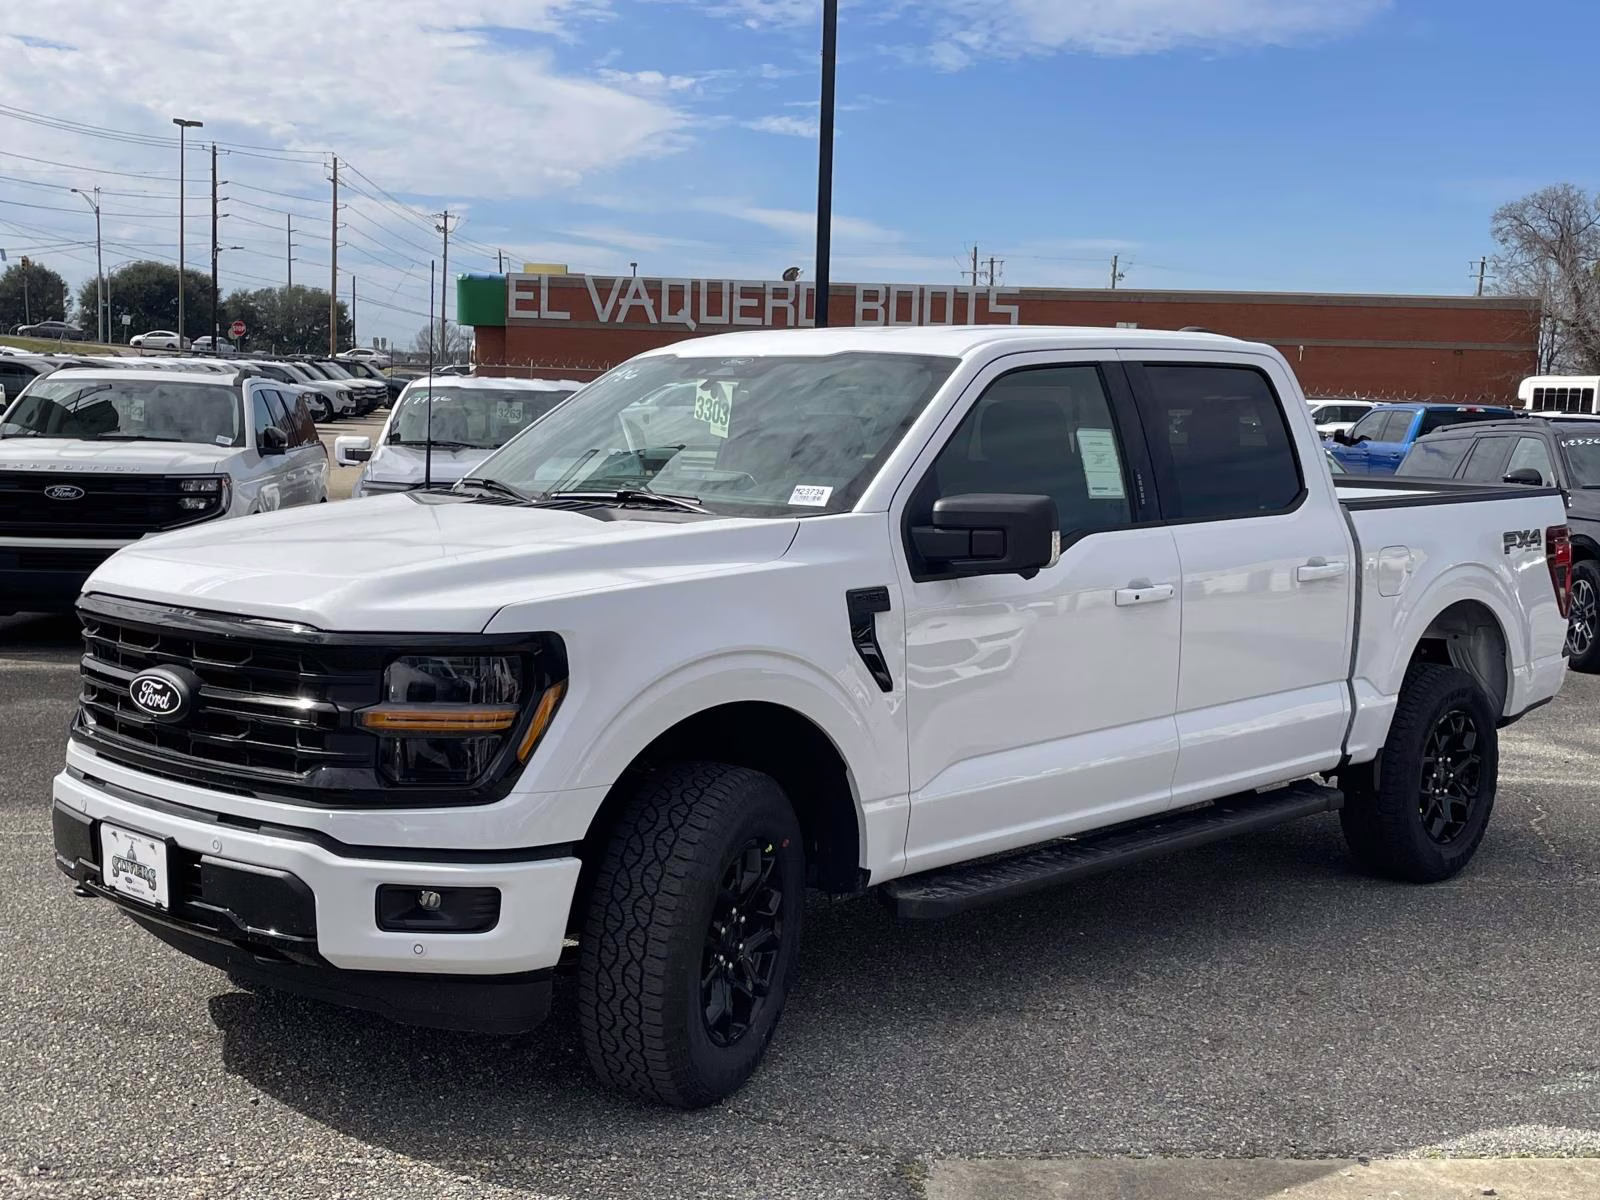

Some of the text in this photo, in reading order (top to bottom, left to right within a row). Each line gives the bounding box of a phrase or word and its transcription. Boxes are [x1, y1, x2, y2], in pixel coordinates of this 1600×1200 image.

[508, 275, 570, 320] EL
[855, 283, 1020, 327] BOOTS
[497, 408, 521, 420] 3263
[695, 396, 730, 426] 3303
[0, 463, 141, 472] EXPEDITION
[52, 487, 77, 497] Ford
[1503, 529, 1541, 554] FX4
[138, 680, 171, 709] Ford
